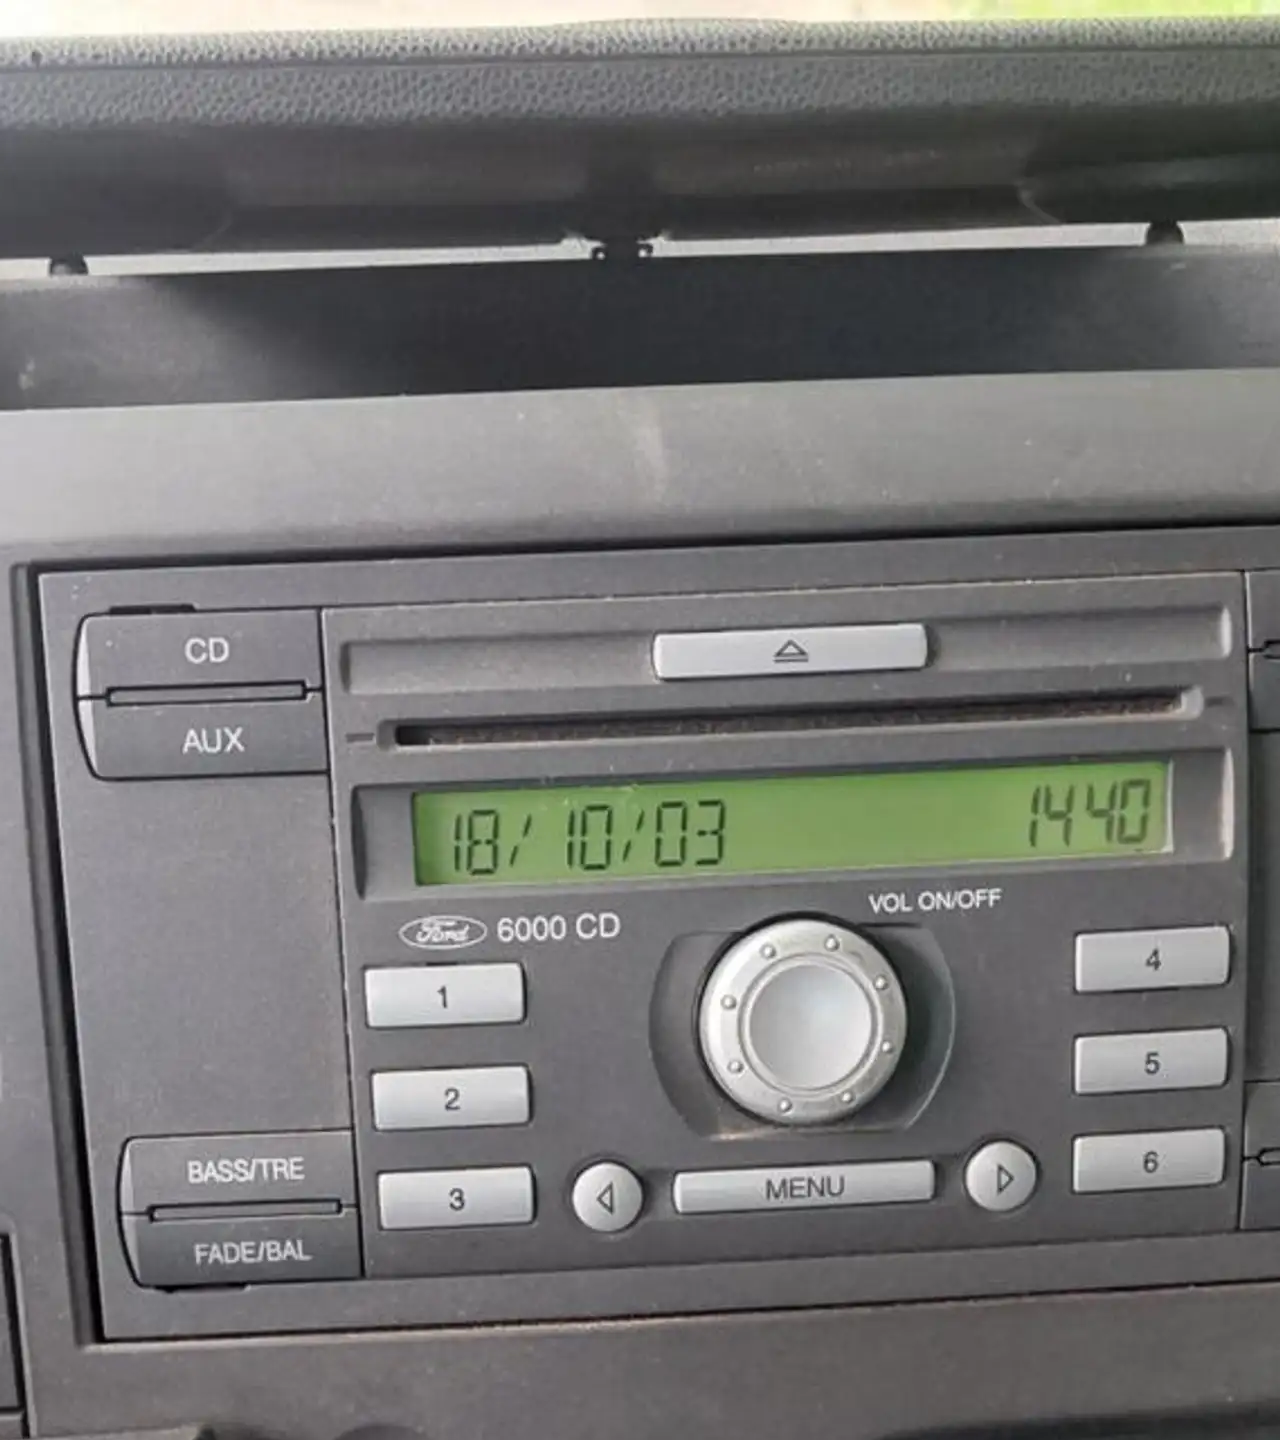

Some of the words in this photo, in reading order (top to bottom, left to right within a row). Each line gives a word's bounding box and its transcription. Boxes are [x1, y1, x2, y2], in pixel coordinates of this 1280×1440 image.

[185, 637, 229, 664] CD
[182, 728, 244, 755] AUX
[868, 890, 912, 914] VOL
[918, 887, 1002, 912] ON/OFF
[412, 917, 477, 946] Ford
[497, 914, 568, 942] 6000
[575, 912, 621, 940] CD
[1145, 947, 1162, 973] 4
[436, 985, 450, 1009] 1
[1144, 1052, 1161, 1076] 5
[443, 1087, 461, 1112] 2
[187, 1157, 305, 1185] BASS/TRE
[1143, 1151, 1160, 1175] 6
[449, 1188, 466, 1212] 3
[765, 1175, 846, 1201] MENU
[194, 1239, 312, 1266] FADE/BAL
